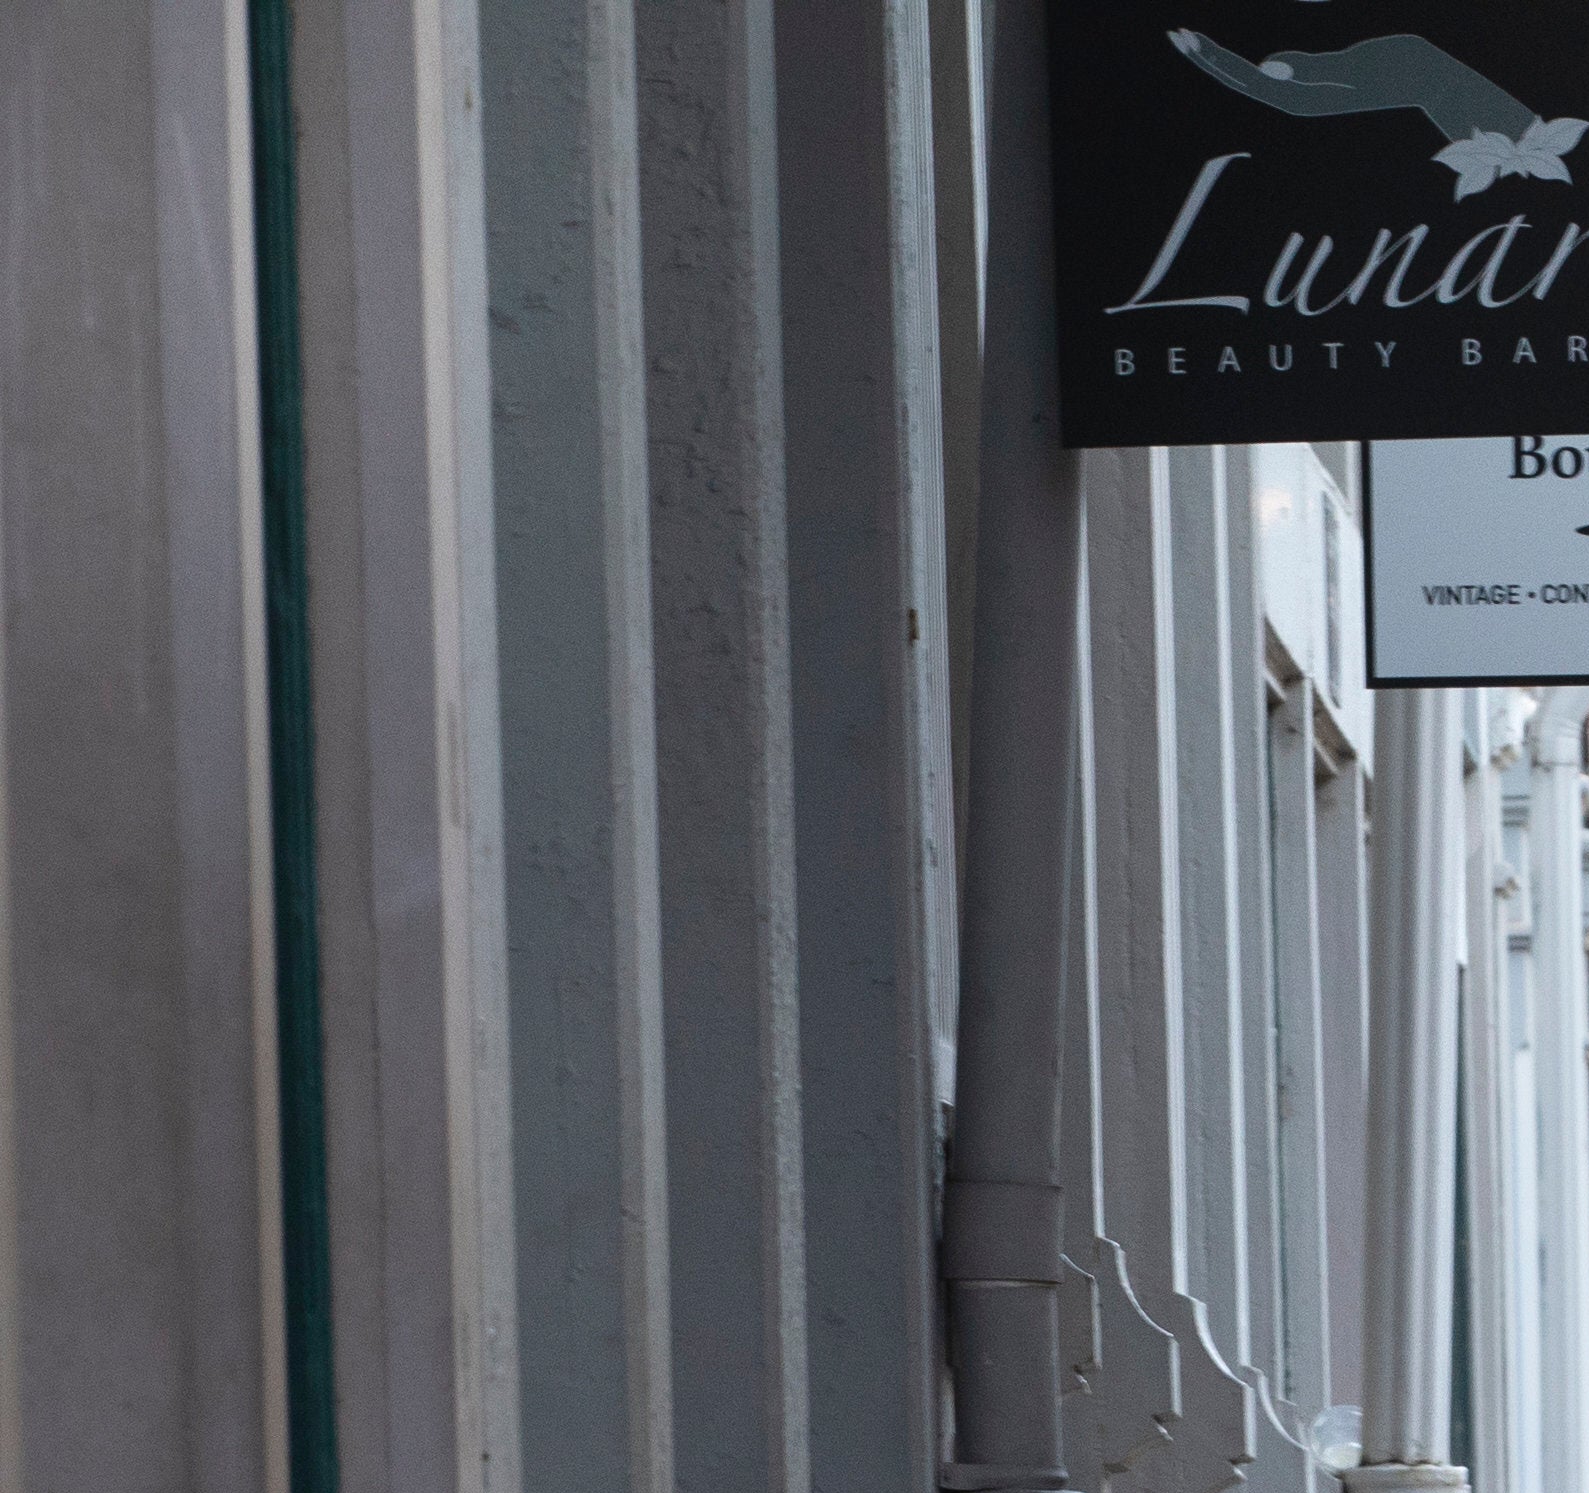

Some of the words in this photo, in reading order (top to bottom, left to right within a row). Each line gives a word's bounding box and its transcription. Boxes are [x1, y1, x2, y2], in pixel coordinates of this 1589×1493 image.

[1114, 341, 1398, 378] BEAUTY
[1462, 335, 1589, 367] BAR
[1421, 584, 1522, 607] VINTAGE
